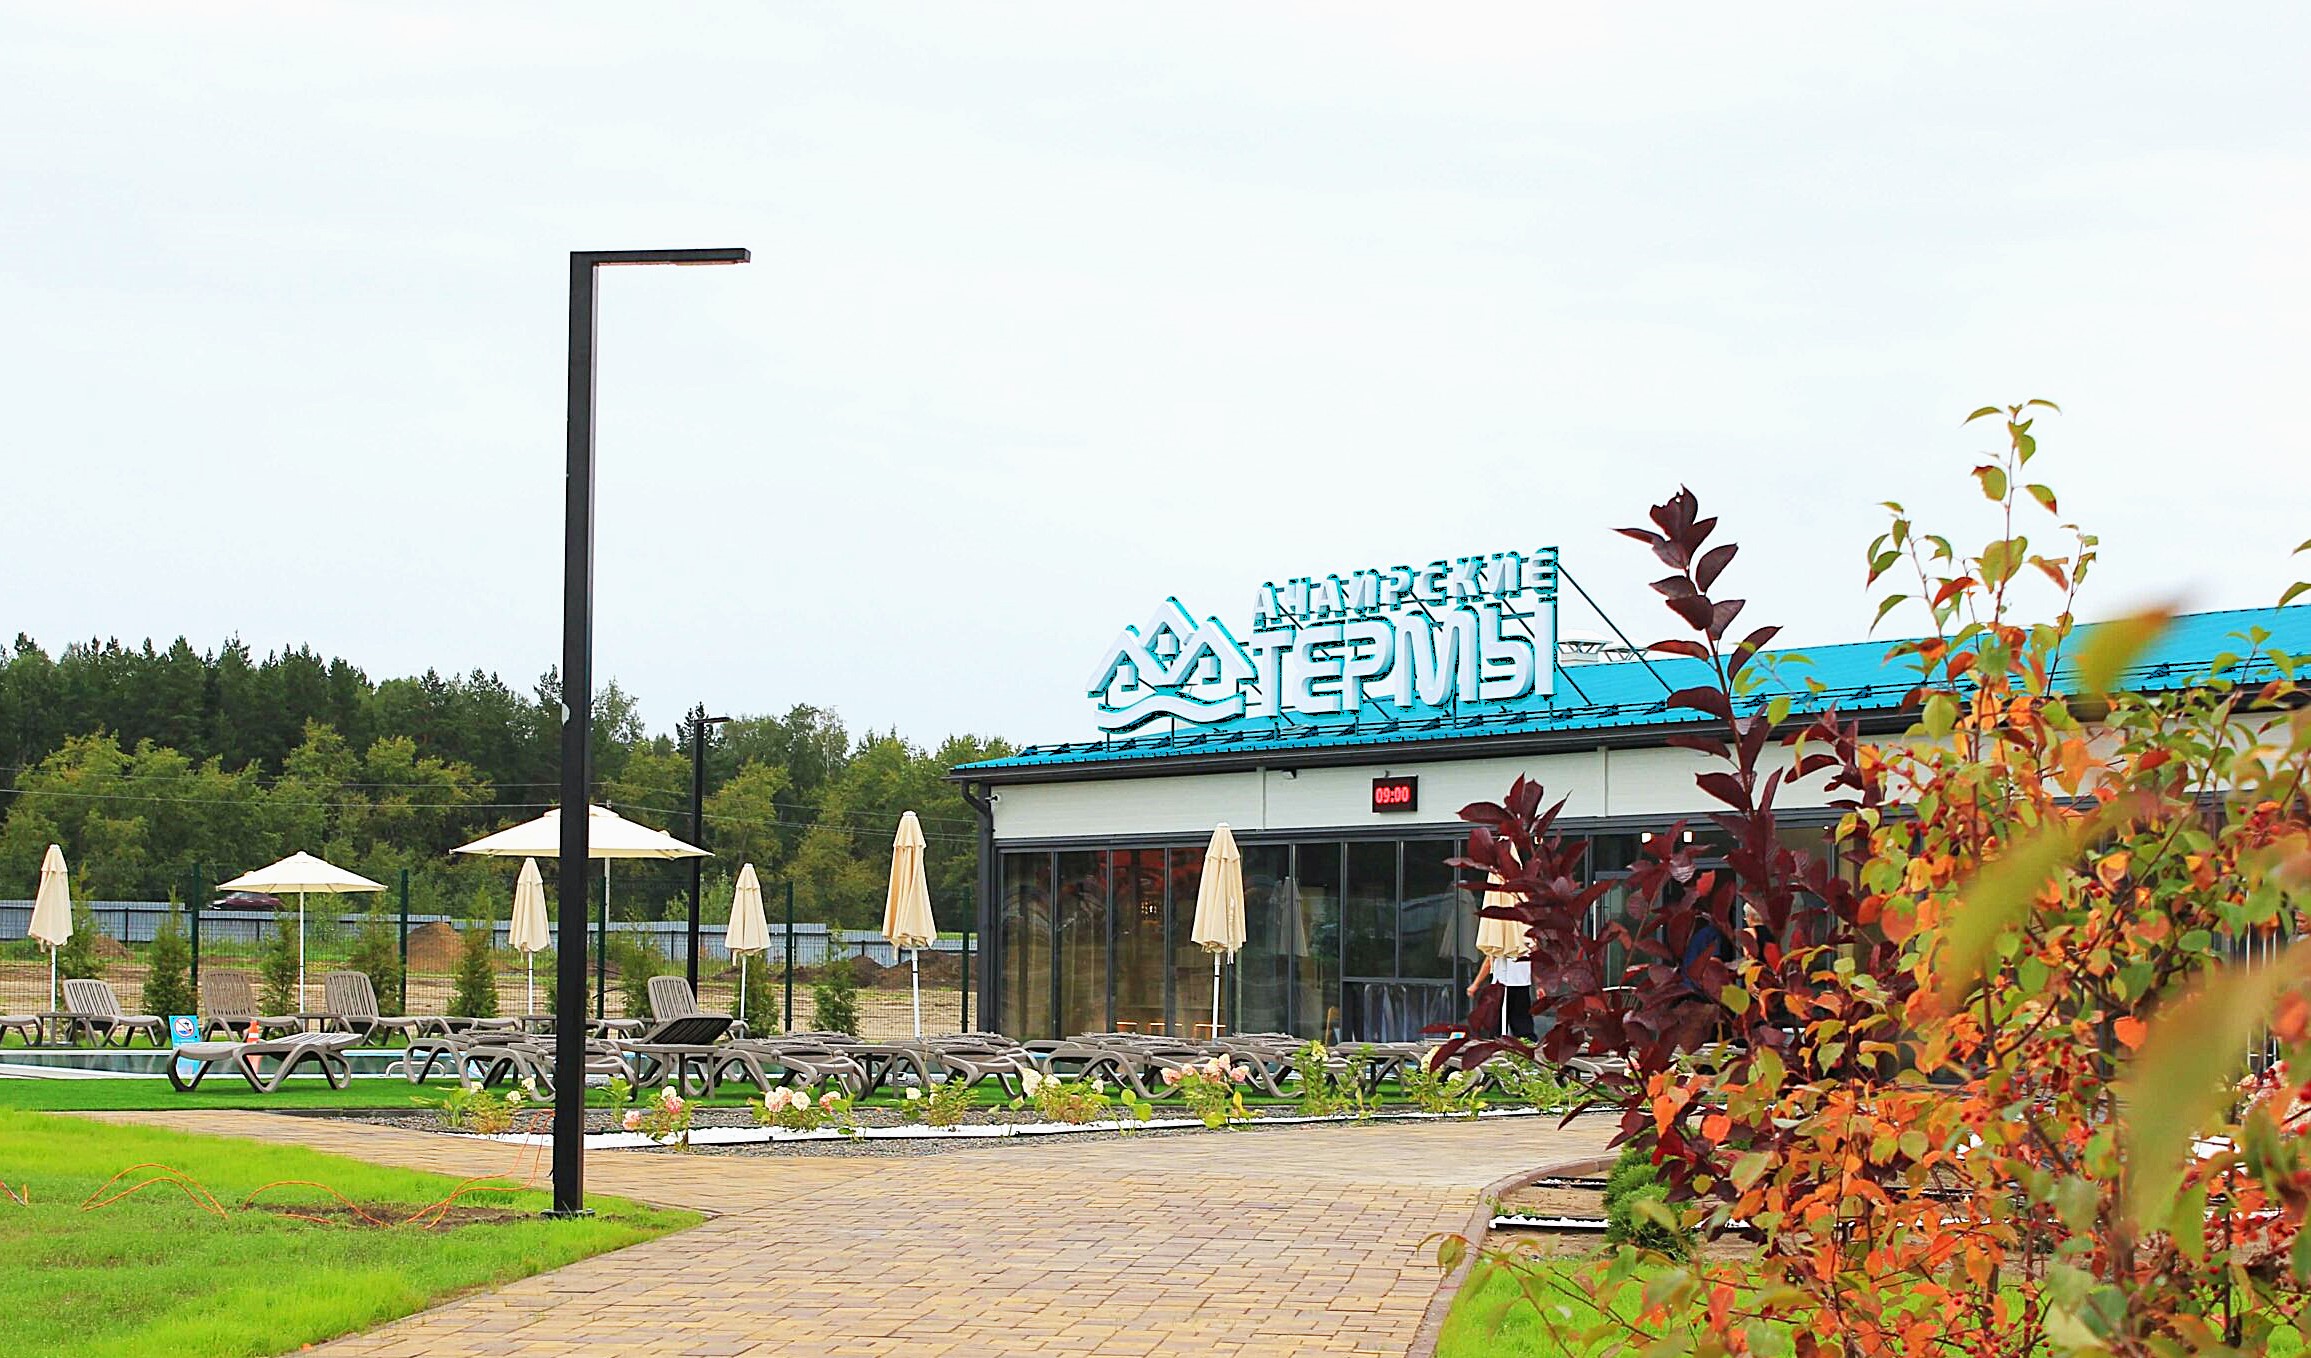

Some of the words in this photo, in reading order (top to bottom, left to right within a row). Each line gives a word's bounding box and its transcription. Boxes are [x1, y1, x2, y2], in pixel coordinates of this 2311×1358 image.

[1251, 547, 1558, 626] АЧАИРСКИЕ
[1245, 598, 1558, 718] ТЕРМЫ
[1374, 785, 1411, 804] 09:00
